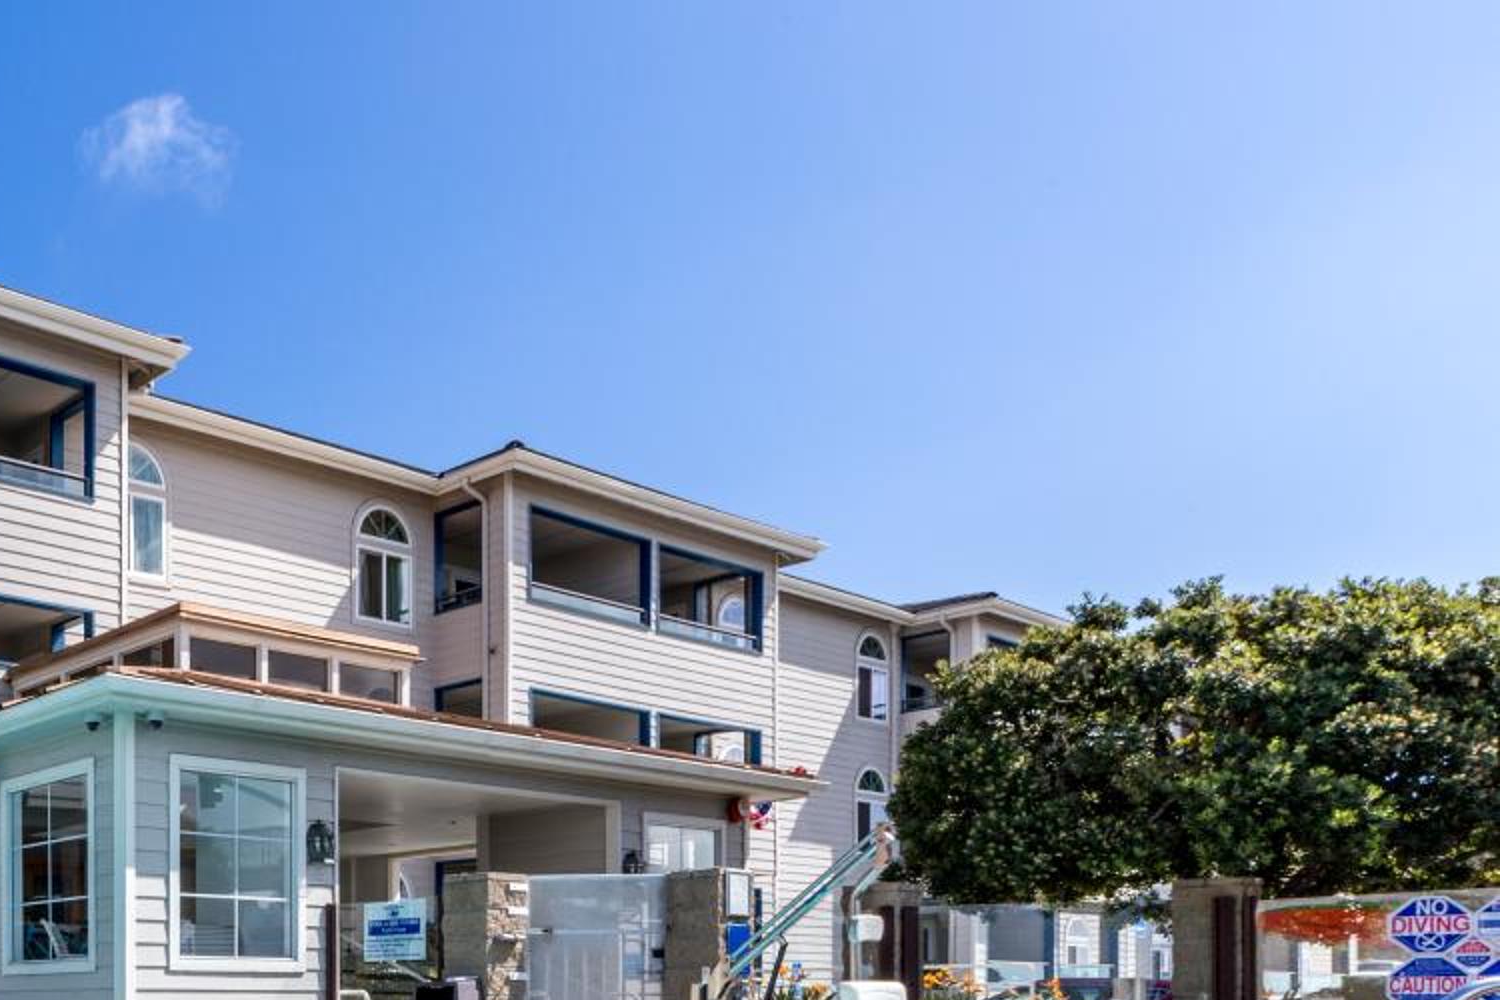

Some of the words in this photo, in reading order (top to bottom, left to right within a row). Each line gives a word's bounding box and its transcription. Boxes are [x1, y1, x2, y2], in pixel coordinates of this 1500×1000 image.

[1415, 899, 1448, 915] NO
[1391, 915, 1470, 933] DIVING
[1389, 976, 1467, 993] CAUTION
